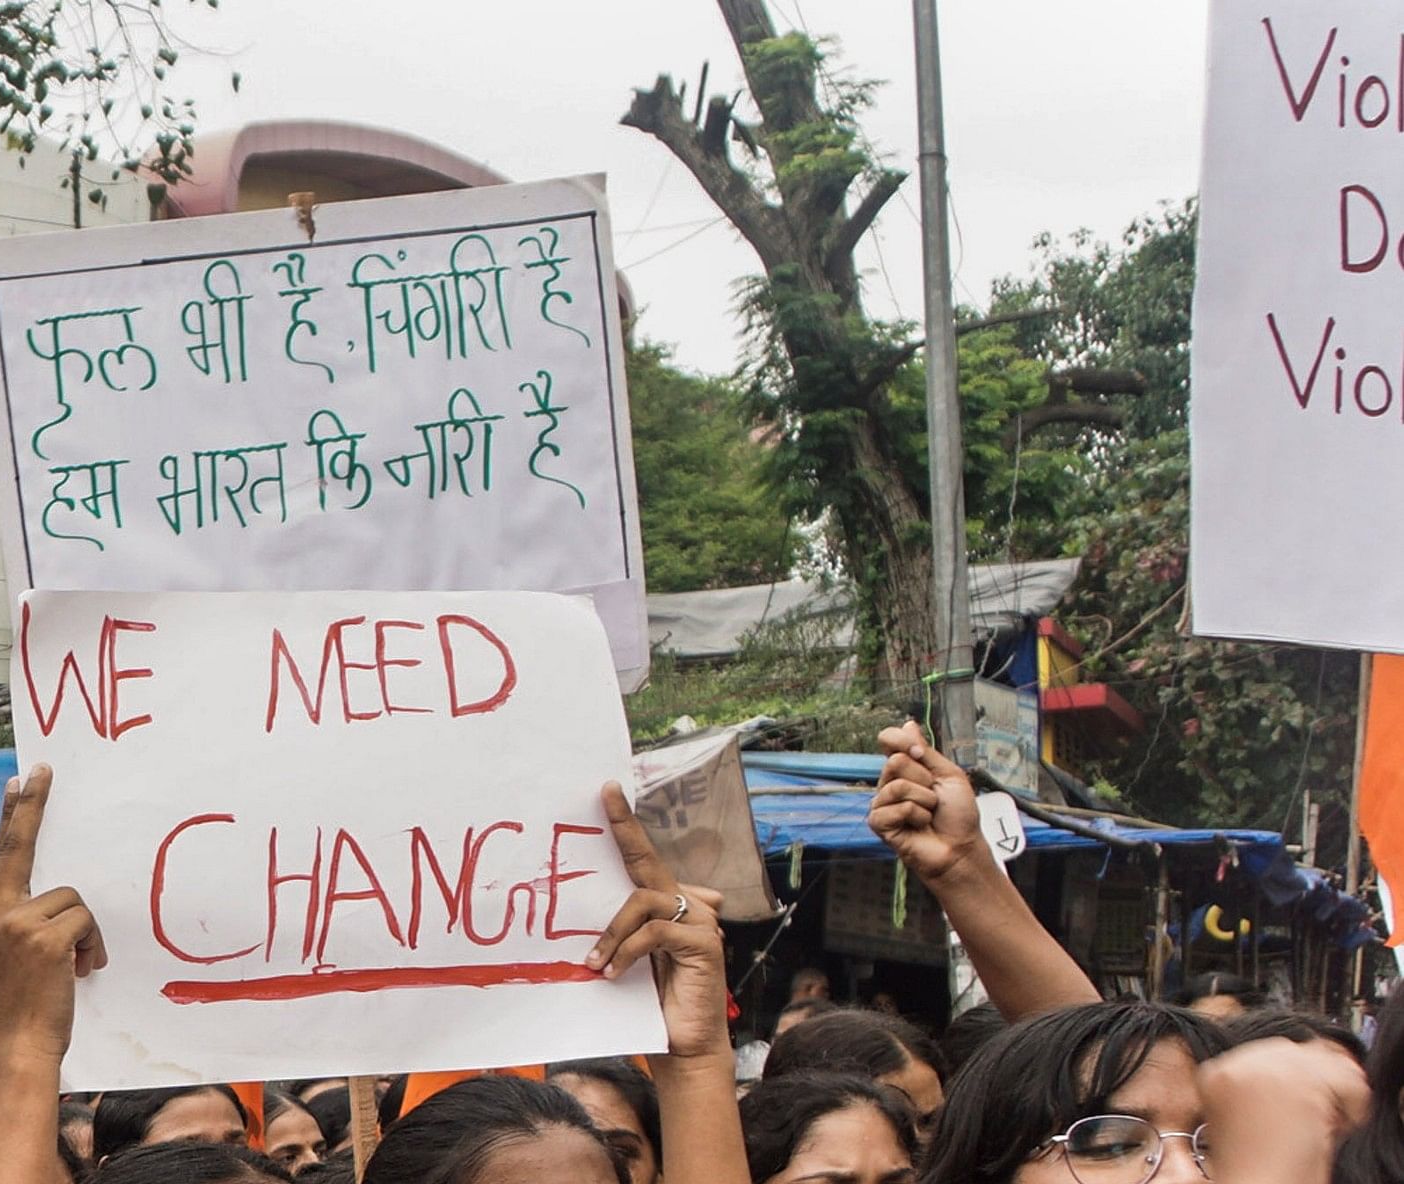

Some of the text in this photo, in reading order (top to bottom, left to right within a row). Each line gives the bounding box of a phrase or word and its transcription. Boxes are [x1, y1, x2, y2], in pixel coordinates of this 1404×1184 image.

[181, 259, 254, 384] भी
[517, 226, 591, 349] है
[1342, 184, 1404, 273] D
[42, 459, 131, 552] हम
[157, 441, 288, 536] भारत
[517, 369, 586, 510] है
[20, 602, 520, 742] WE NEED
[149, 812, 607, 968] CHANGE
